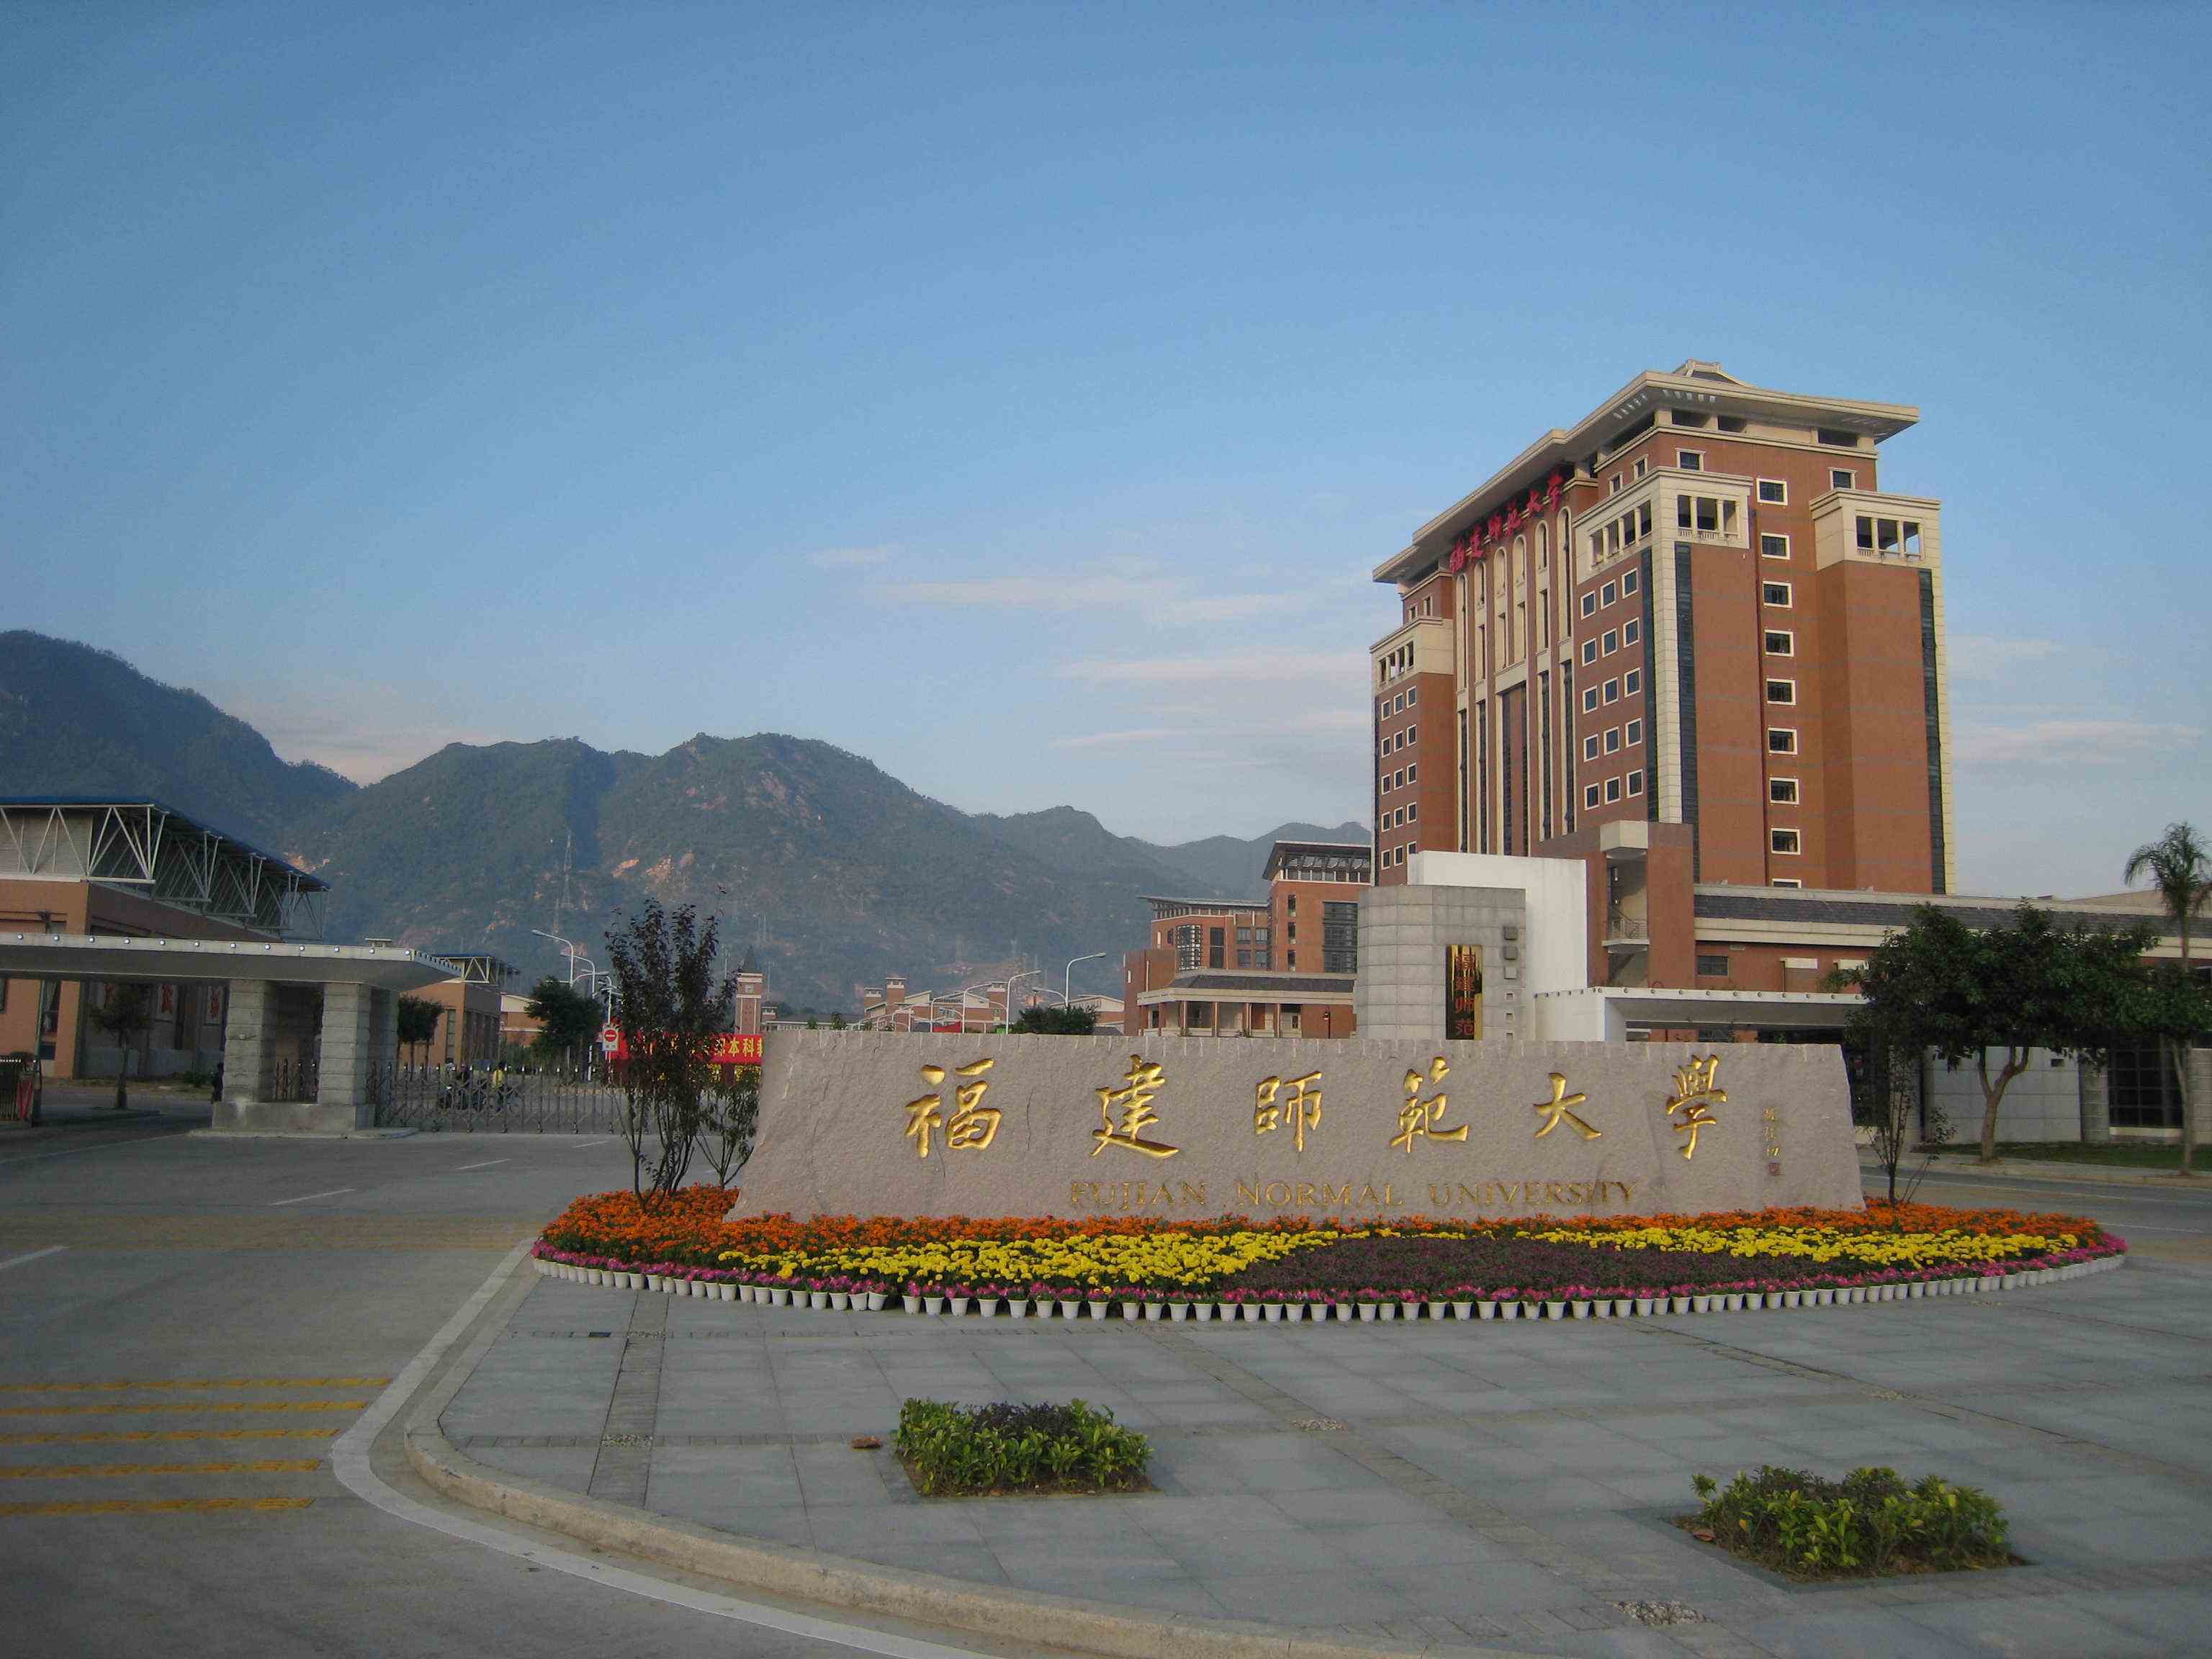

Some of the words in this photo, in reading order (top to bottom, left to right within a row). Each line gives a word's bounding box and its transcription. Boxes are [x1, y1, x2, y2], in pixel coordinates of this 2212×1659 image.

[905, 1054, 1727, 1159] 福建師範大學
[1070, 1181, 1208, 1210] FUJIAN
[1237, 1182, 1403, 1206] NORMAL
[1429, 1181, 1637, 1206] UNIVERSITY
